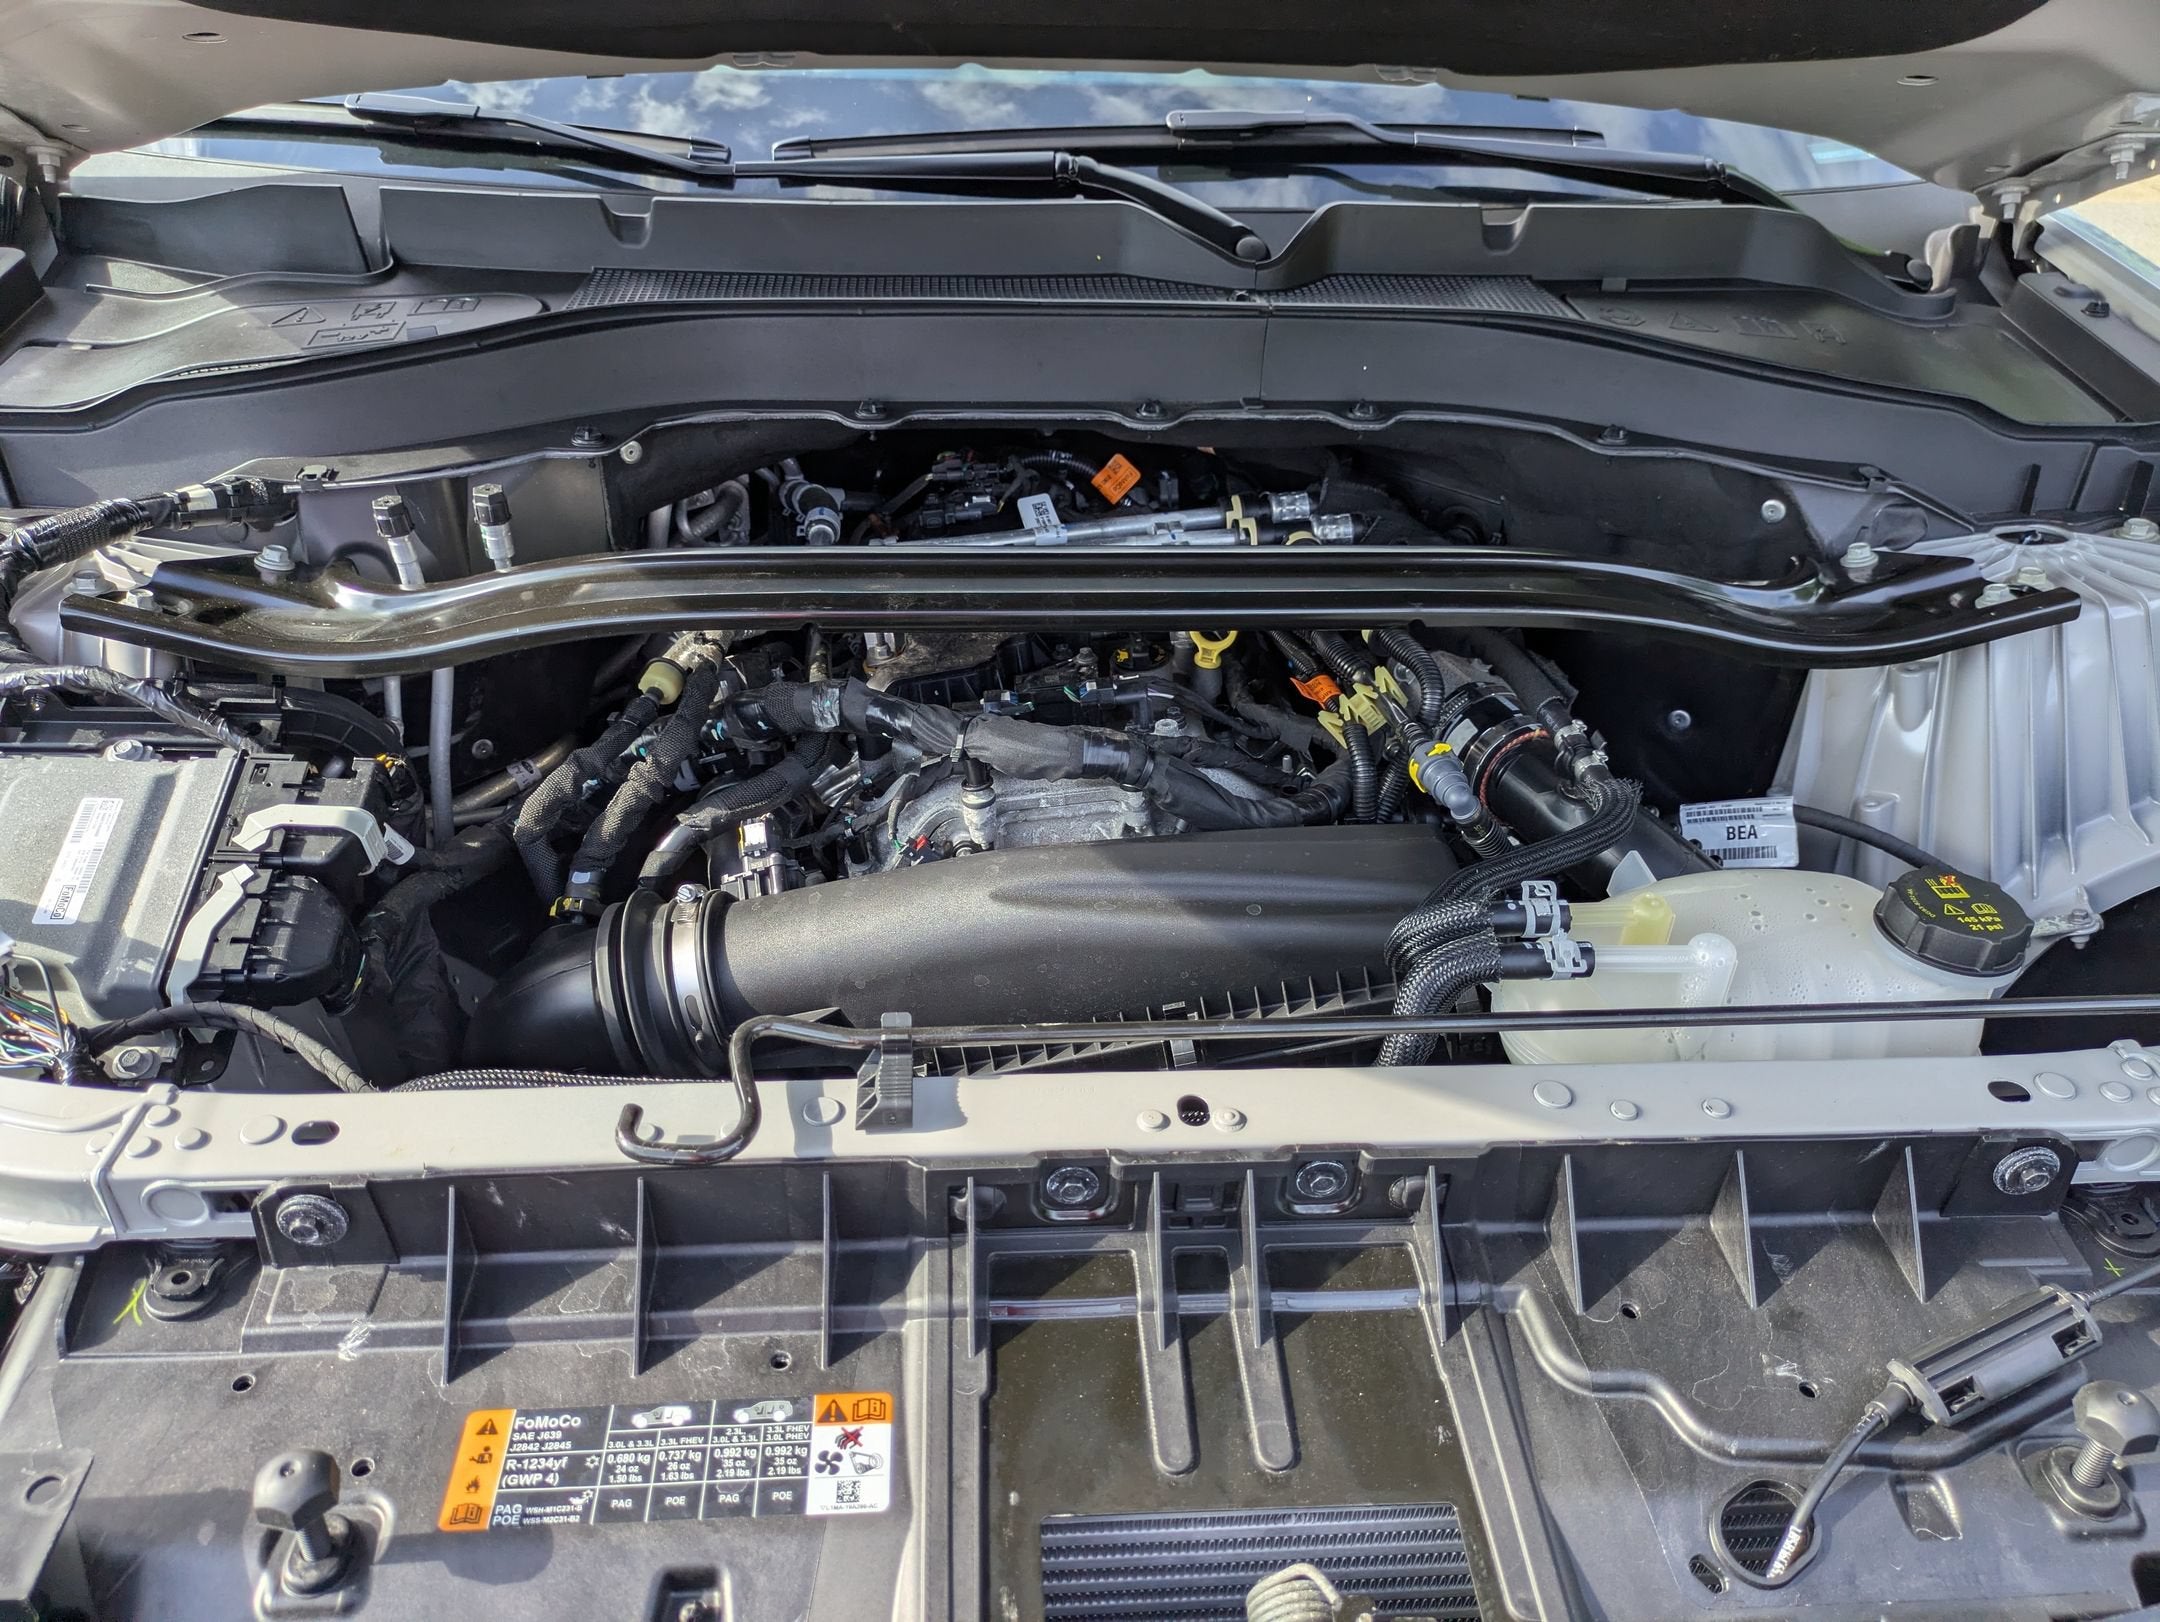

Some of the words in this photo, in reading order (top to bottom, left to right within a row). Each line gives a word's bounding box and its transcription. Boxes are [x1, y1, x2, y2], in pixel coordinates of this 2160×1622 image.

[1726, 825, 1758, 841] BEA
[53, 886, 74, 918] FoMoCo
[1986, 923, 2004, 931] psi
[514, 1414, 581, 1430] FoMoCo
[767, 1425, 784, 1433] 3.3L
[786, 1424, 810, 1432] FHEV
[512, 1432, 535, 1441] SAE
[537, 1431, 562, 1440] J639
[660, 1438, 678, 1446] 3.3L
[679, 1436, 704, 1444] FHEV
[732, 1435, 739, 1443] &
[741, 1434, 758, 1442] 3.3L
[766, 1433, 784, 1441] 3.0L
[785, 1432, 810, 1440] PHEV
[509, 1443, 539, 1452] J2842
[541, 1441, 571, 1451] J2845
[608, 1441, 626, 1449] 3.0L
[627, 1440, 635, 1448] &
[637, 1440, 654, 1448] 3.3L
[658, 1450, 686, 1461] 0.737
[688, 1449, 702, 1462] kg
[714, 1447, 742, 1458] 0.992
[743, 1446, 757, 1459] kg
[765, 1446, 793, 1457] 0.992
[794, 1445, 808, 1457] kg
[506, 1456, 568, 1471] R-1234yf
[607, 1453, 635, 1464] 0.680
[637, 1452, 651, 1465] kg
[722, 1459, 734, 1467] 35
[735, 1459, 746, 1467] oz
[773, 1457, 785, 1465] 35
[786, 1457, 798, 1465] oz
[615, 1465, 627, 1473] 24
[628, 1465, 639, 1473] oz
[667, 1462, 678, 1471] 26
[679, 1462, 691, 1470] oz
[767, 1467, 787, 1476] 2.19
[788, 1466, 802, 1475] lbs
[660, 1472, 679, 1481] 1.63
[680, 1471, 694, 1480] lbs
[716, 1469, 735, 1478] 2.19
[736, 1468, 750, 1477] lbs
[502, 1473, 543, 1488] (GWP
[545, 1472, 559, 1486] 4)
[609, 1475, 627, 1483] 1.50
[629, 1474, 643, 1482] lbs
[718, 1494, 740, 1503] PAG
[772, 1491, 793, 1500] POE
[611, 1499, 632, 1508] PAG
[665, 1496, 686, 1506] POE
[495, 1504, 522, 1515] PAG
[492, 1514, 520, 1526] POE
